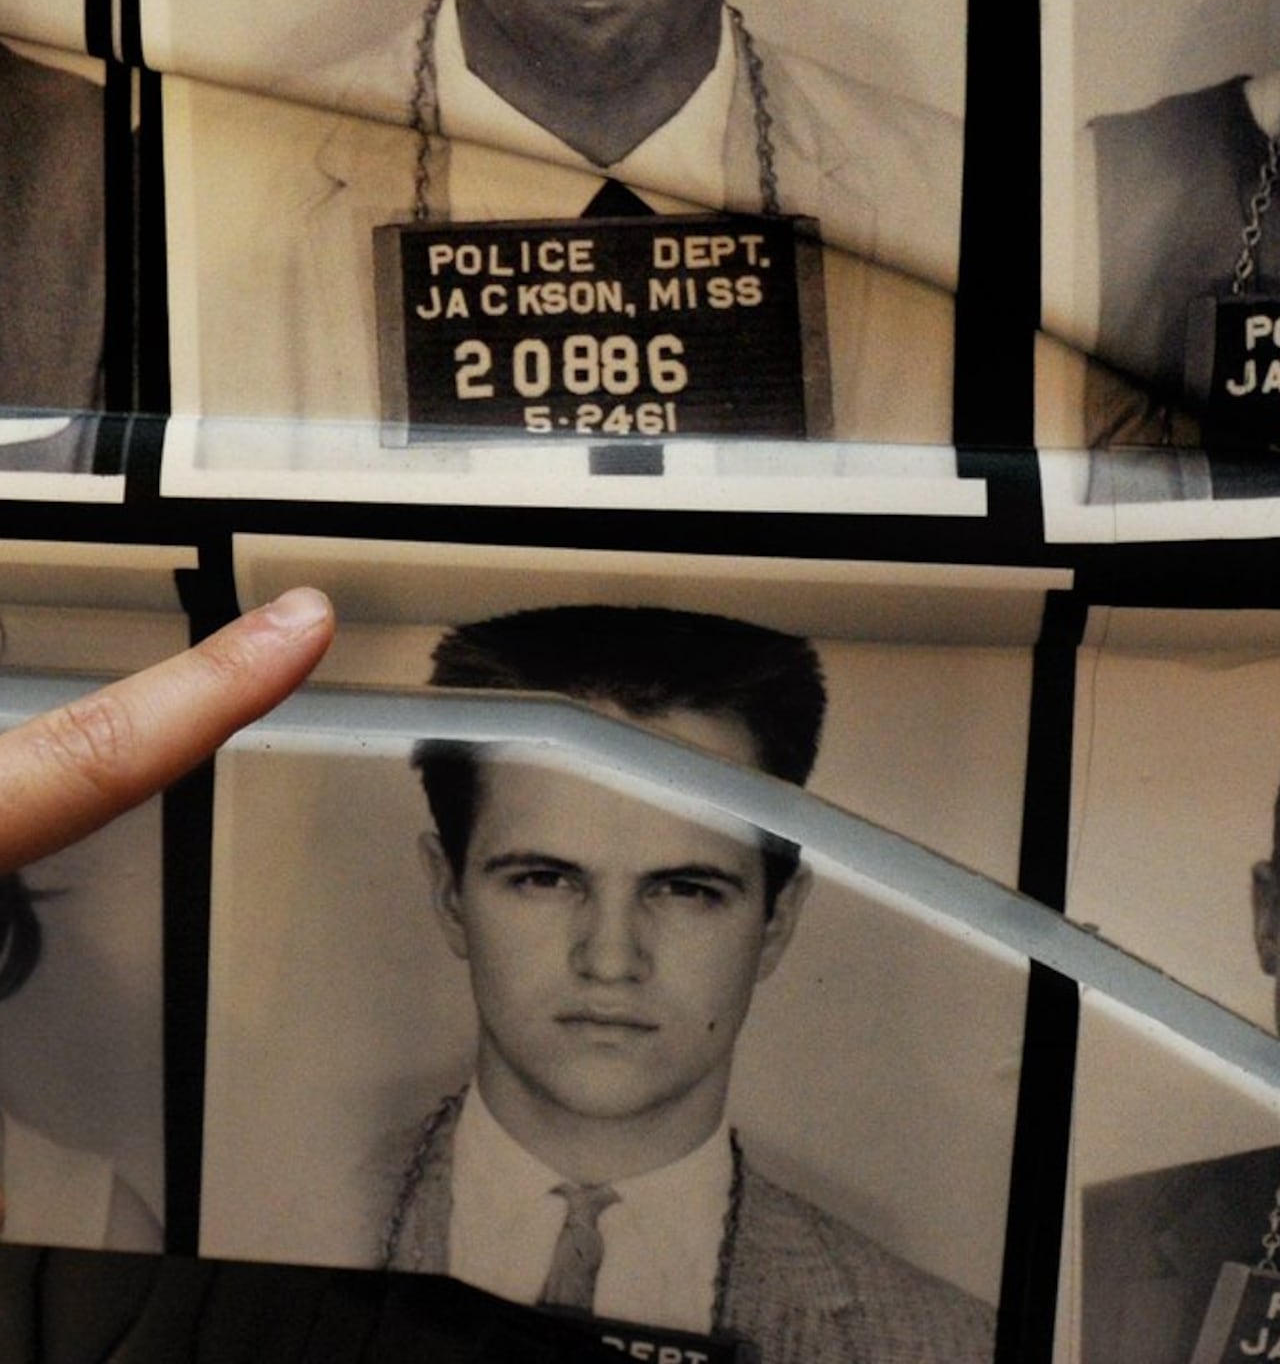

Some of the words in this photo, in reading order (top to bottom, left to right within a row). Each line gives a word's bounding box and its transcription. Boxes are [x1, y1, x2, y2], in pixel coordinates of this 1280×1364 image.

[428, 239, 595, 277] POLICE
[652, 235, 771, 270] DEPT.
[416, 280, 637, 319] JACKSON,
[649, 275, 764, 311] MISS
[453, 334, 688, 400] 20886
